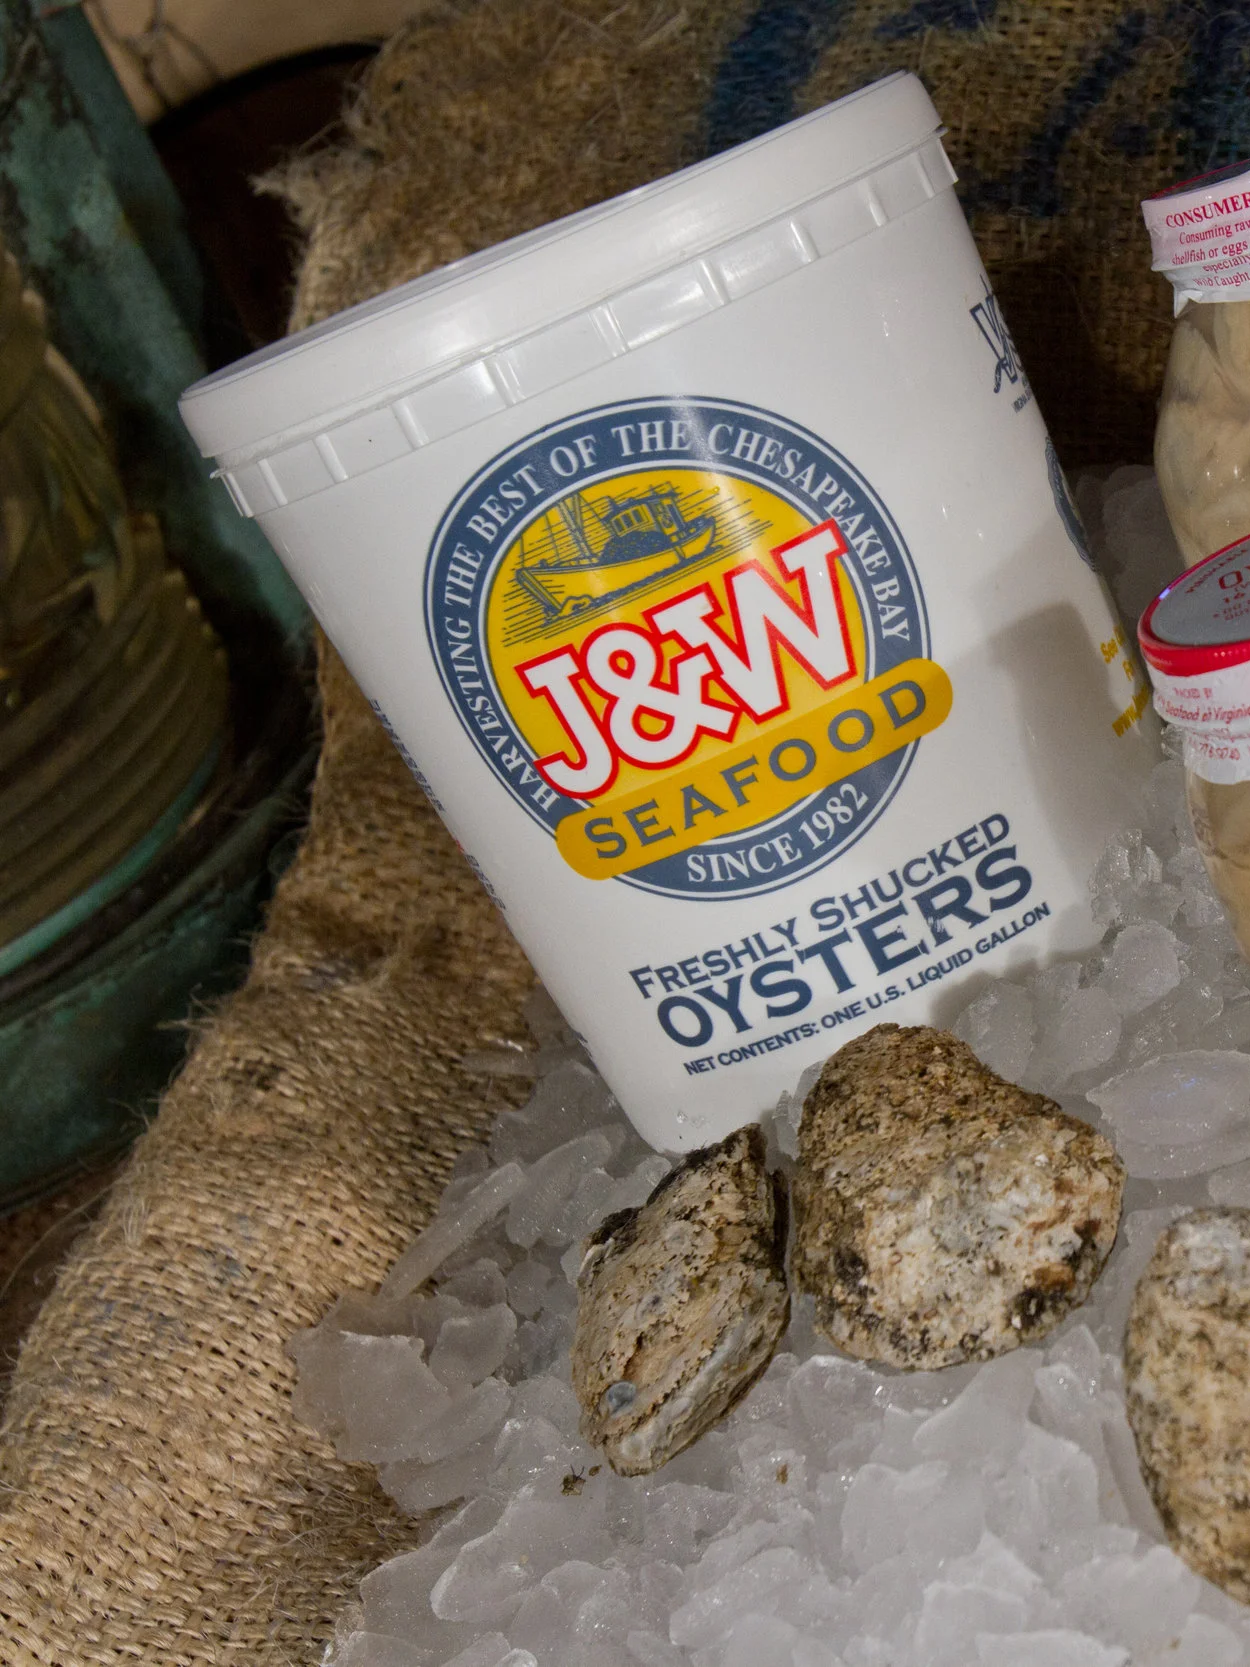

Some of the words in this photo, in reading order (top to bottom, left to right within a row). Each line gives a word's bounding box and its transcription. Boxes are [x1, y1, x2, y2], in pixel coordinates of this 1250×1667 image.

[1172, 248, 1206, 266] shellfish
[1208, 247, 1219, 259] or
[1222, 240, 1248, 257] eggs
[1179, 224, 1232, 245] Consuming
[1216, 272, 1250, 287] Caught
[549, 434, 599, 479] OF
[611, 419, 692, 458] THE
[467, 464, 547, 542] BEST
[707, 422, 890, 577] CHESAPEAKE
[445, 542, 485, 608] THE
[871, 577, 912, 642] BAY
[514, 518, 858, 800] J&W
[444, 616, 561, 813] HARVESTING
[583, 680, 927, 859] SEAFOOD
[686, 831, 802, 884] SINCE
[798, 782, 869, 852] 1982
[629, 917, 799, 999] FRESHLY
[810, 813, 1010, 932] SHUCKED
[656, 844, 1033, 1048] OYSTERS
[683, 1049, 719, 1076] NET
[717, 1022, 819, 1065] CONTENTS:
[820, 1000, 867, 1030] ONE
[867, 986, 907, 1011] U.S.
[907, 947, 974, 992] LIQUID
[975, 901, 1051, 956] GALLON
